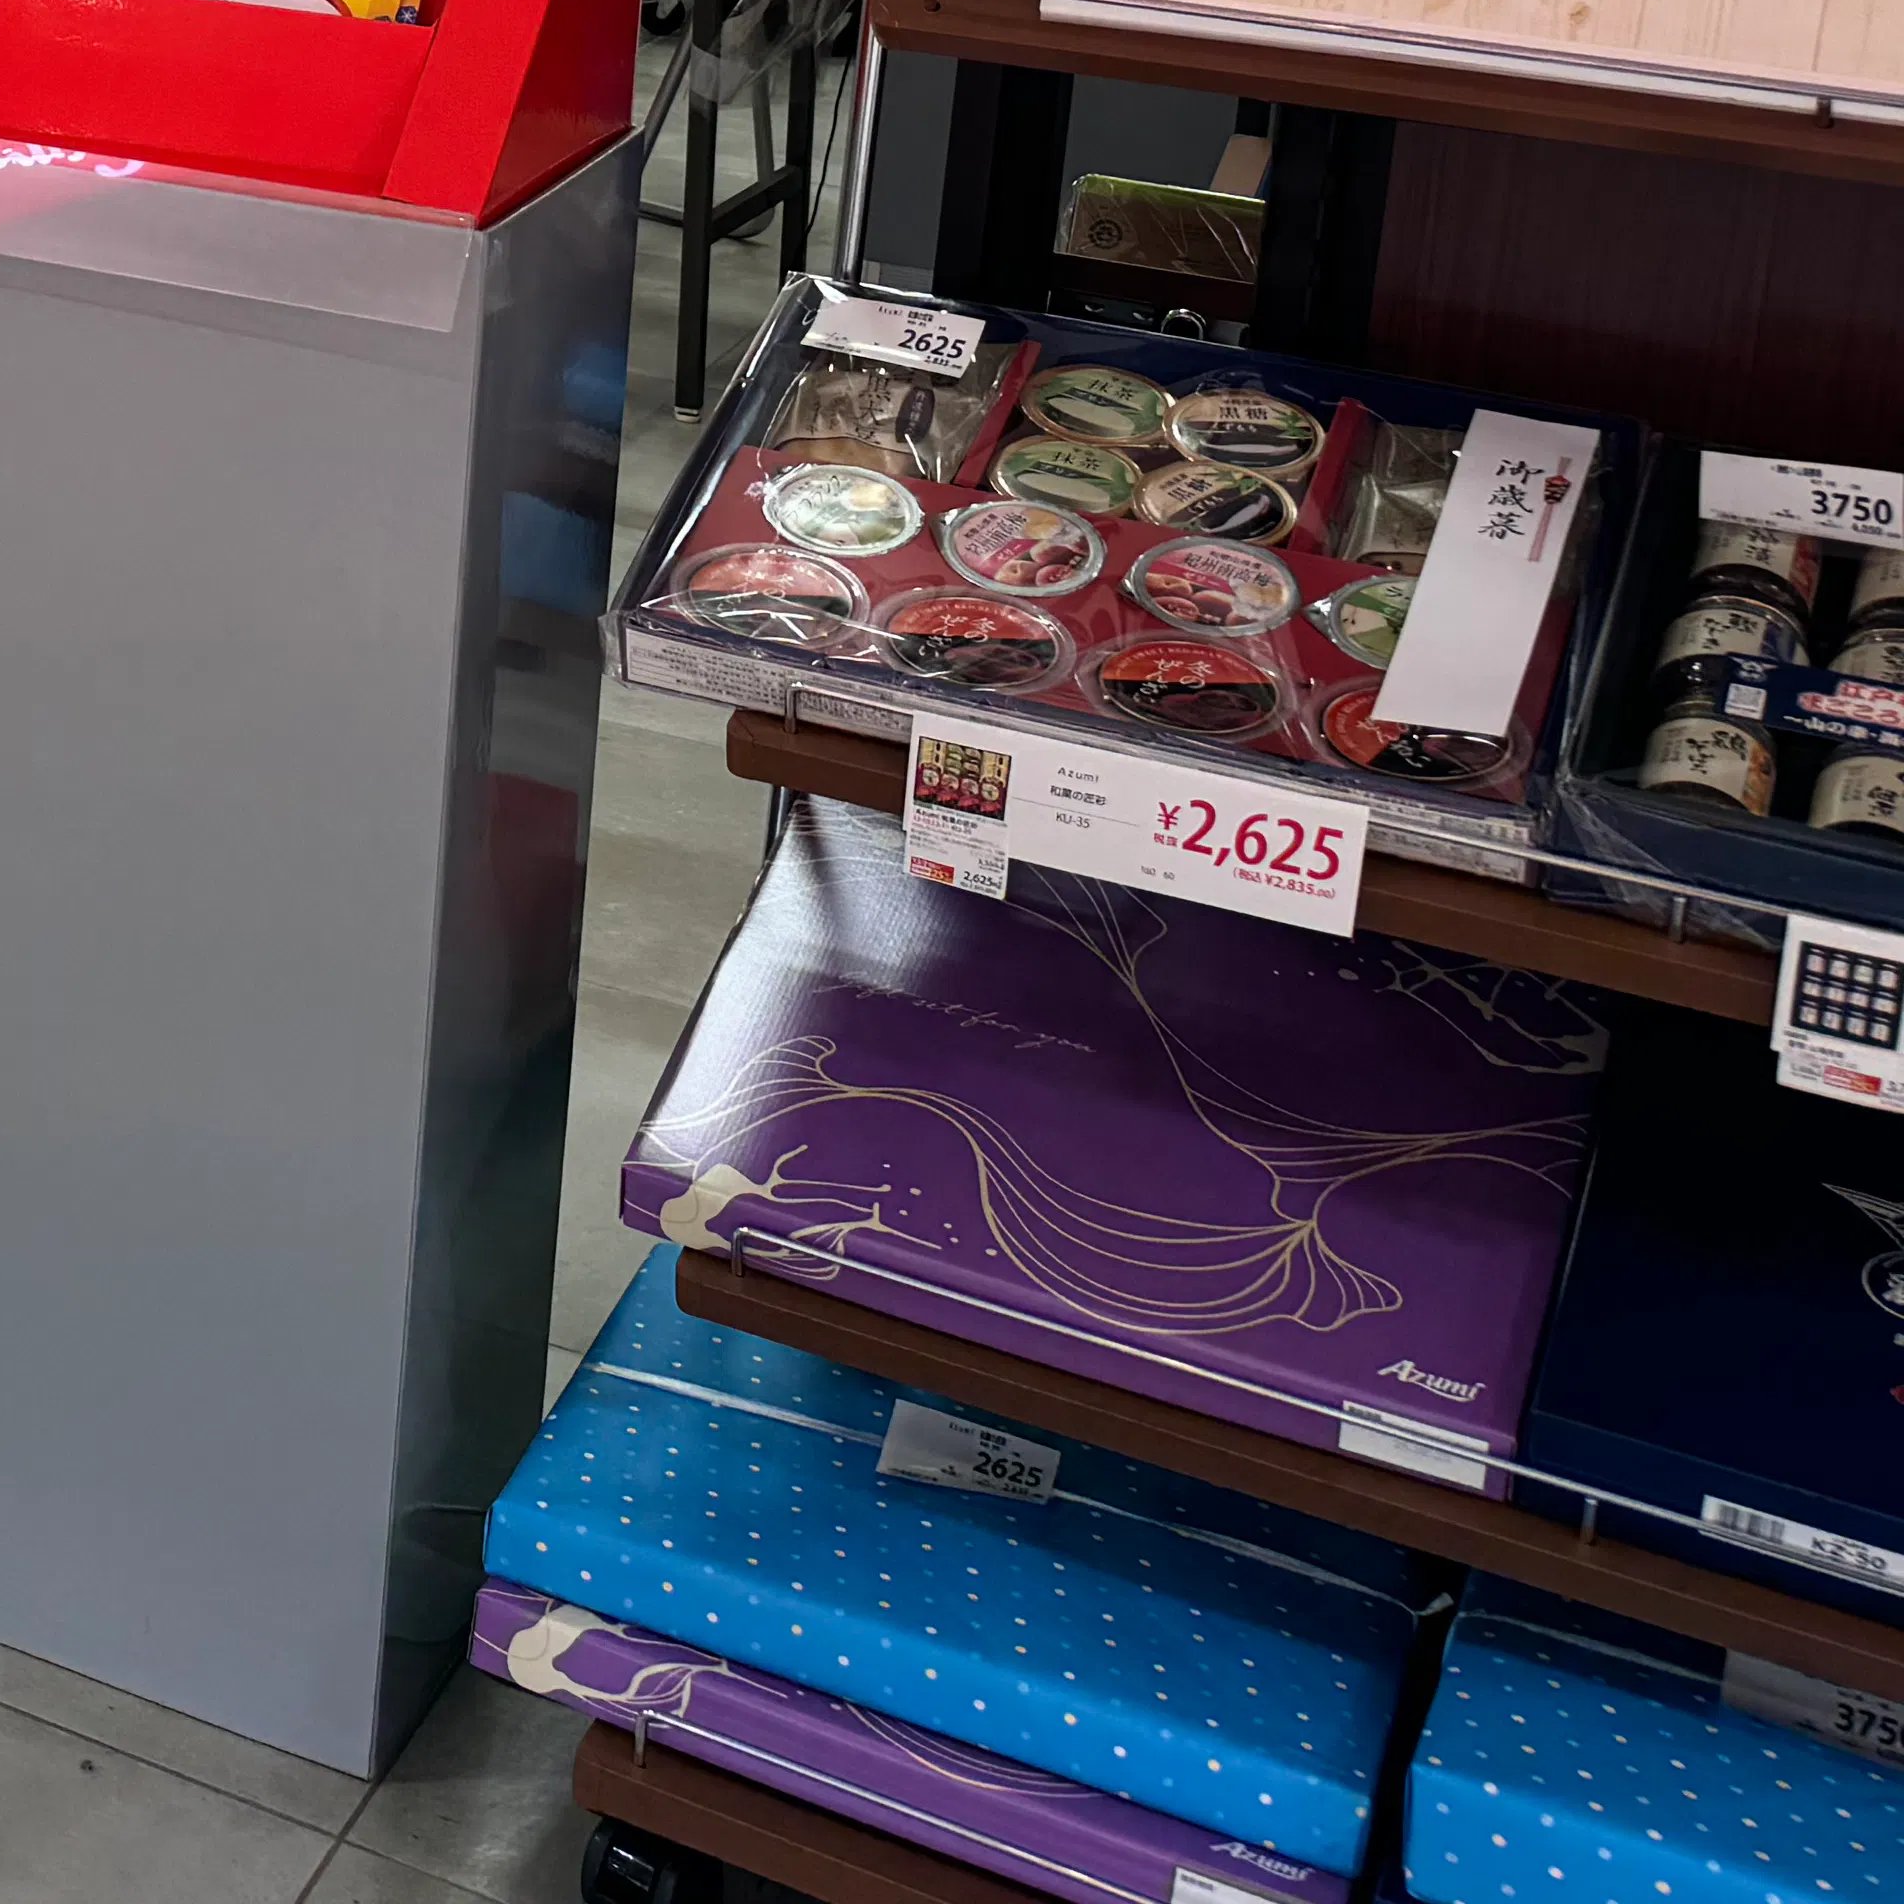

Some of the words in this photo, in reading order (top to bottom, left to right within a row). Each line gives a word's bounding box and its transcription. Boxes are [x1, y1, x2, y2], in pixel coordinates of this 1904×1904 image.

[898, 328, 966, 359] 2625
[1218, 405, 1269, 421] 黒糖
[1810, 489, 1892, 525] 3750
[1055, 811, 1091, 829] KU-35
[1376, 1359, 1487, 1403] Azumi
[972, 1451, 1044, 1487] 2625
[1835, 1700, 1904, 1748] 375
